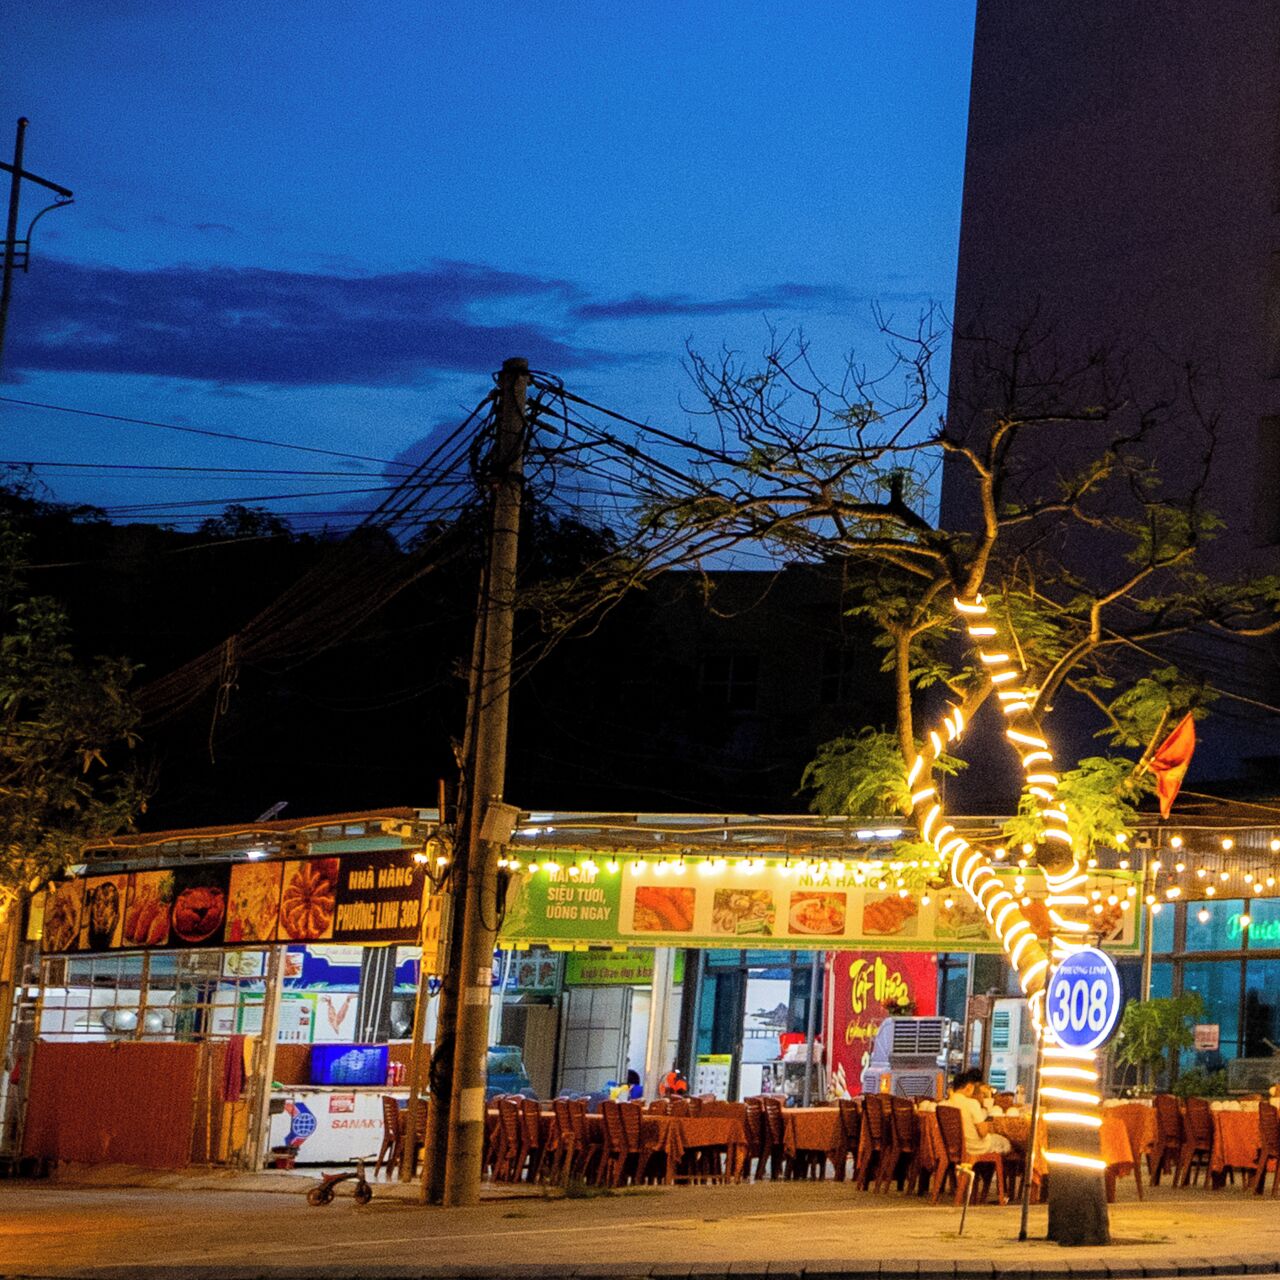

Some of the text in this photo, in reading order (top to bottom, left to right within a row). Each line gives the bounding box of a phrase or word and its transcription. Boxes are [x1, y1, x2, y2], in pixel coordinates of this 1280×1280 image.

[349, 864, 413, 890] NHÀ HÀNG
[375, 900, 399, 929] LINH
[400, 900, 420, 928] 308
[580, 907, 612, 920] NGAY
[1052, 979, 1108, 1031] 308
